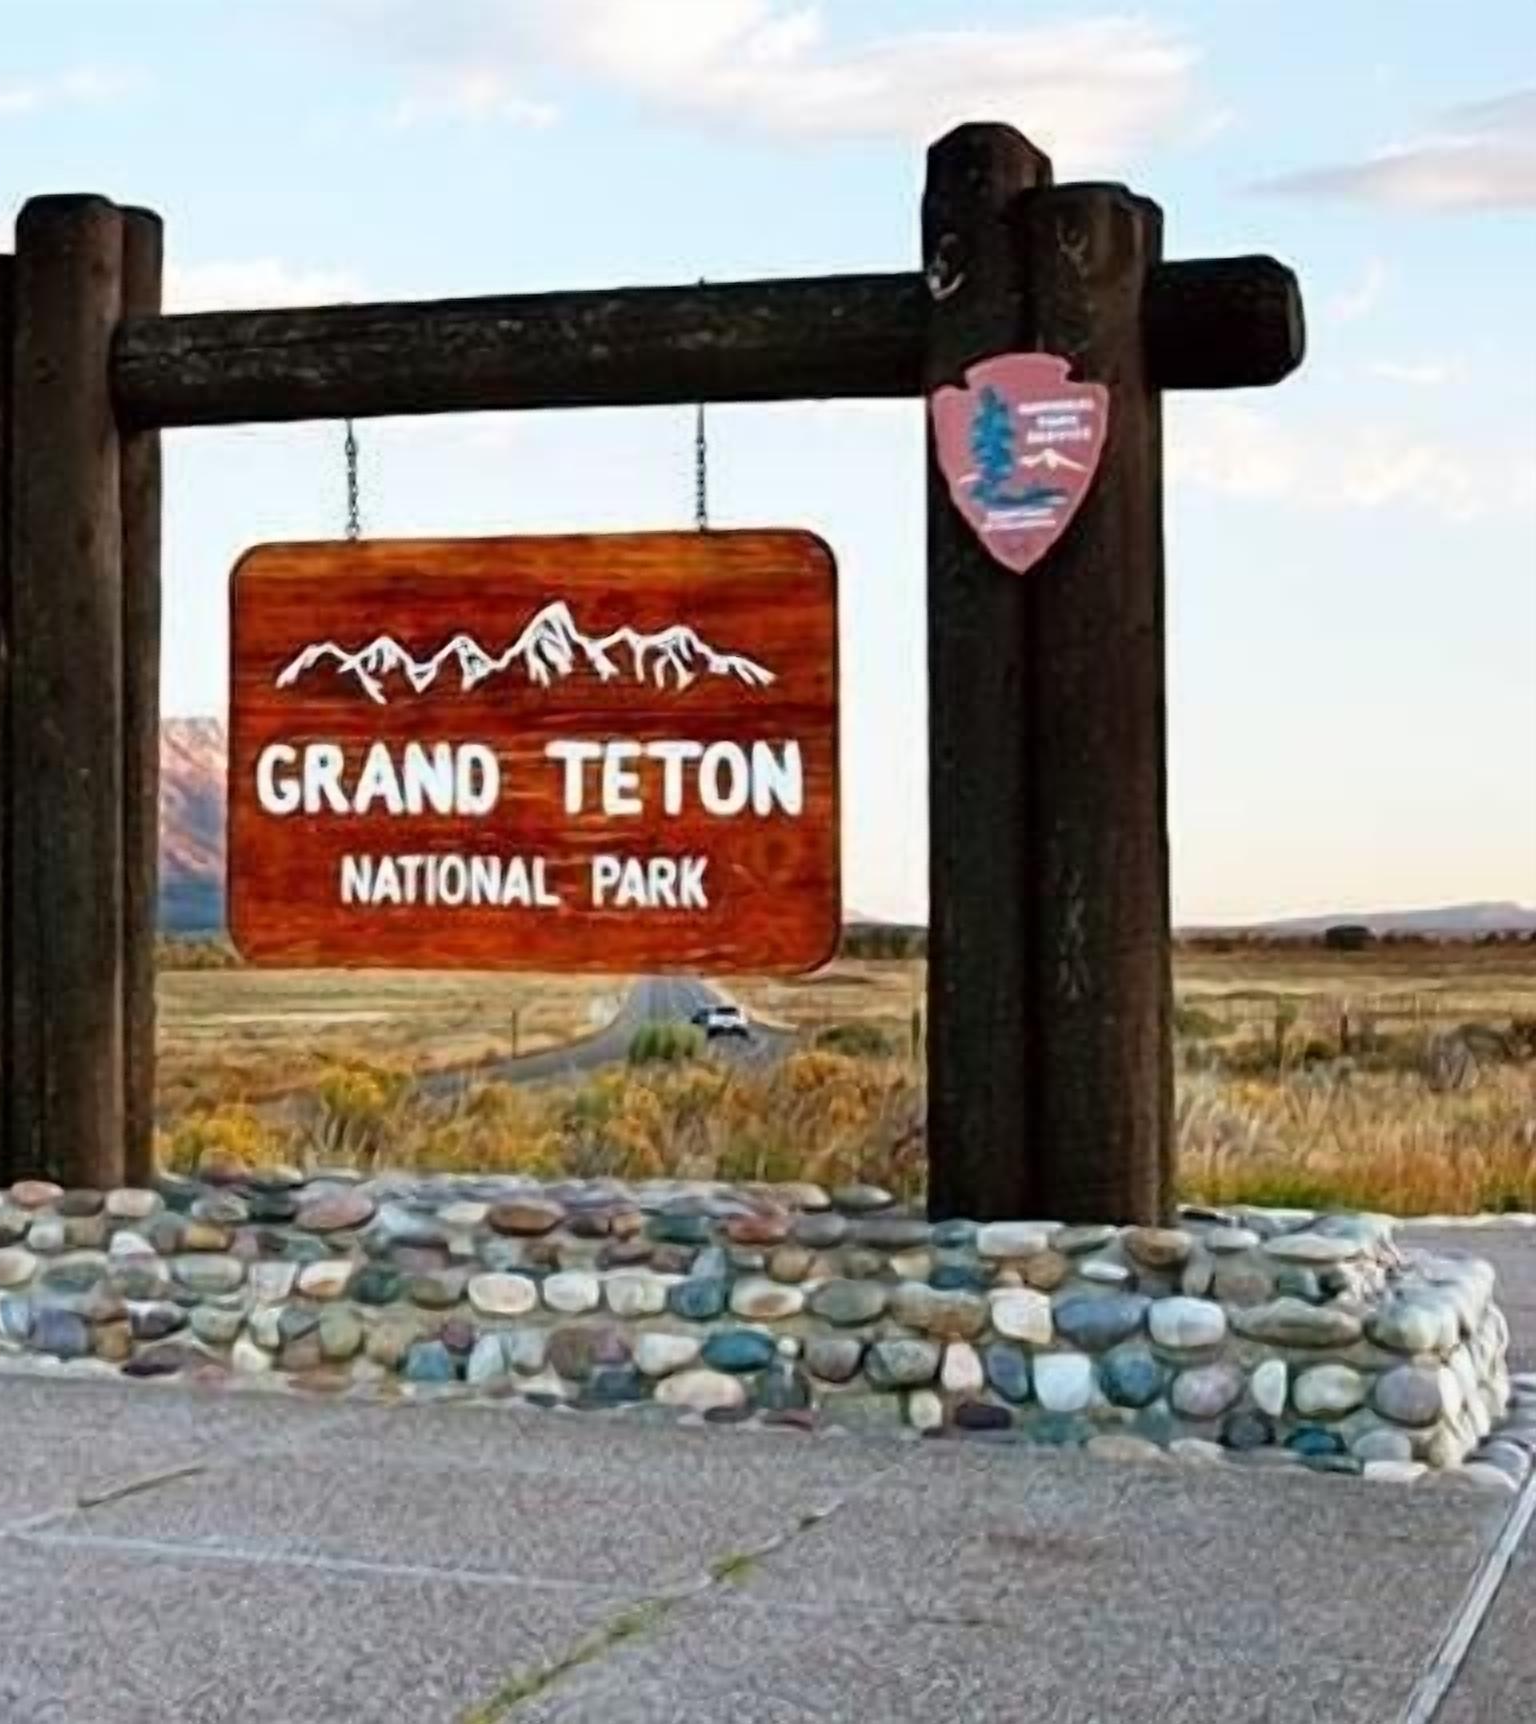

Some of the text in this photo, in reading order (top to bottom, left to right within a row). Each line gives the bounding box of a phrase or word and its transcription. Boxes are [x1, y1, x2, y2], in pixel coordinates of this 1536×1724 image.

[256, 739, 804, 817] GRAND TETON
[340, 853, 709, 908] NATIONAL PARK
